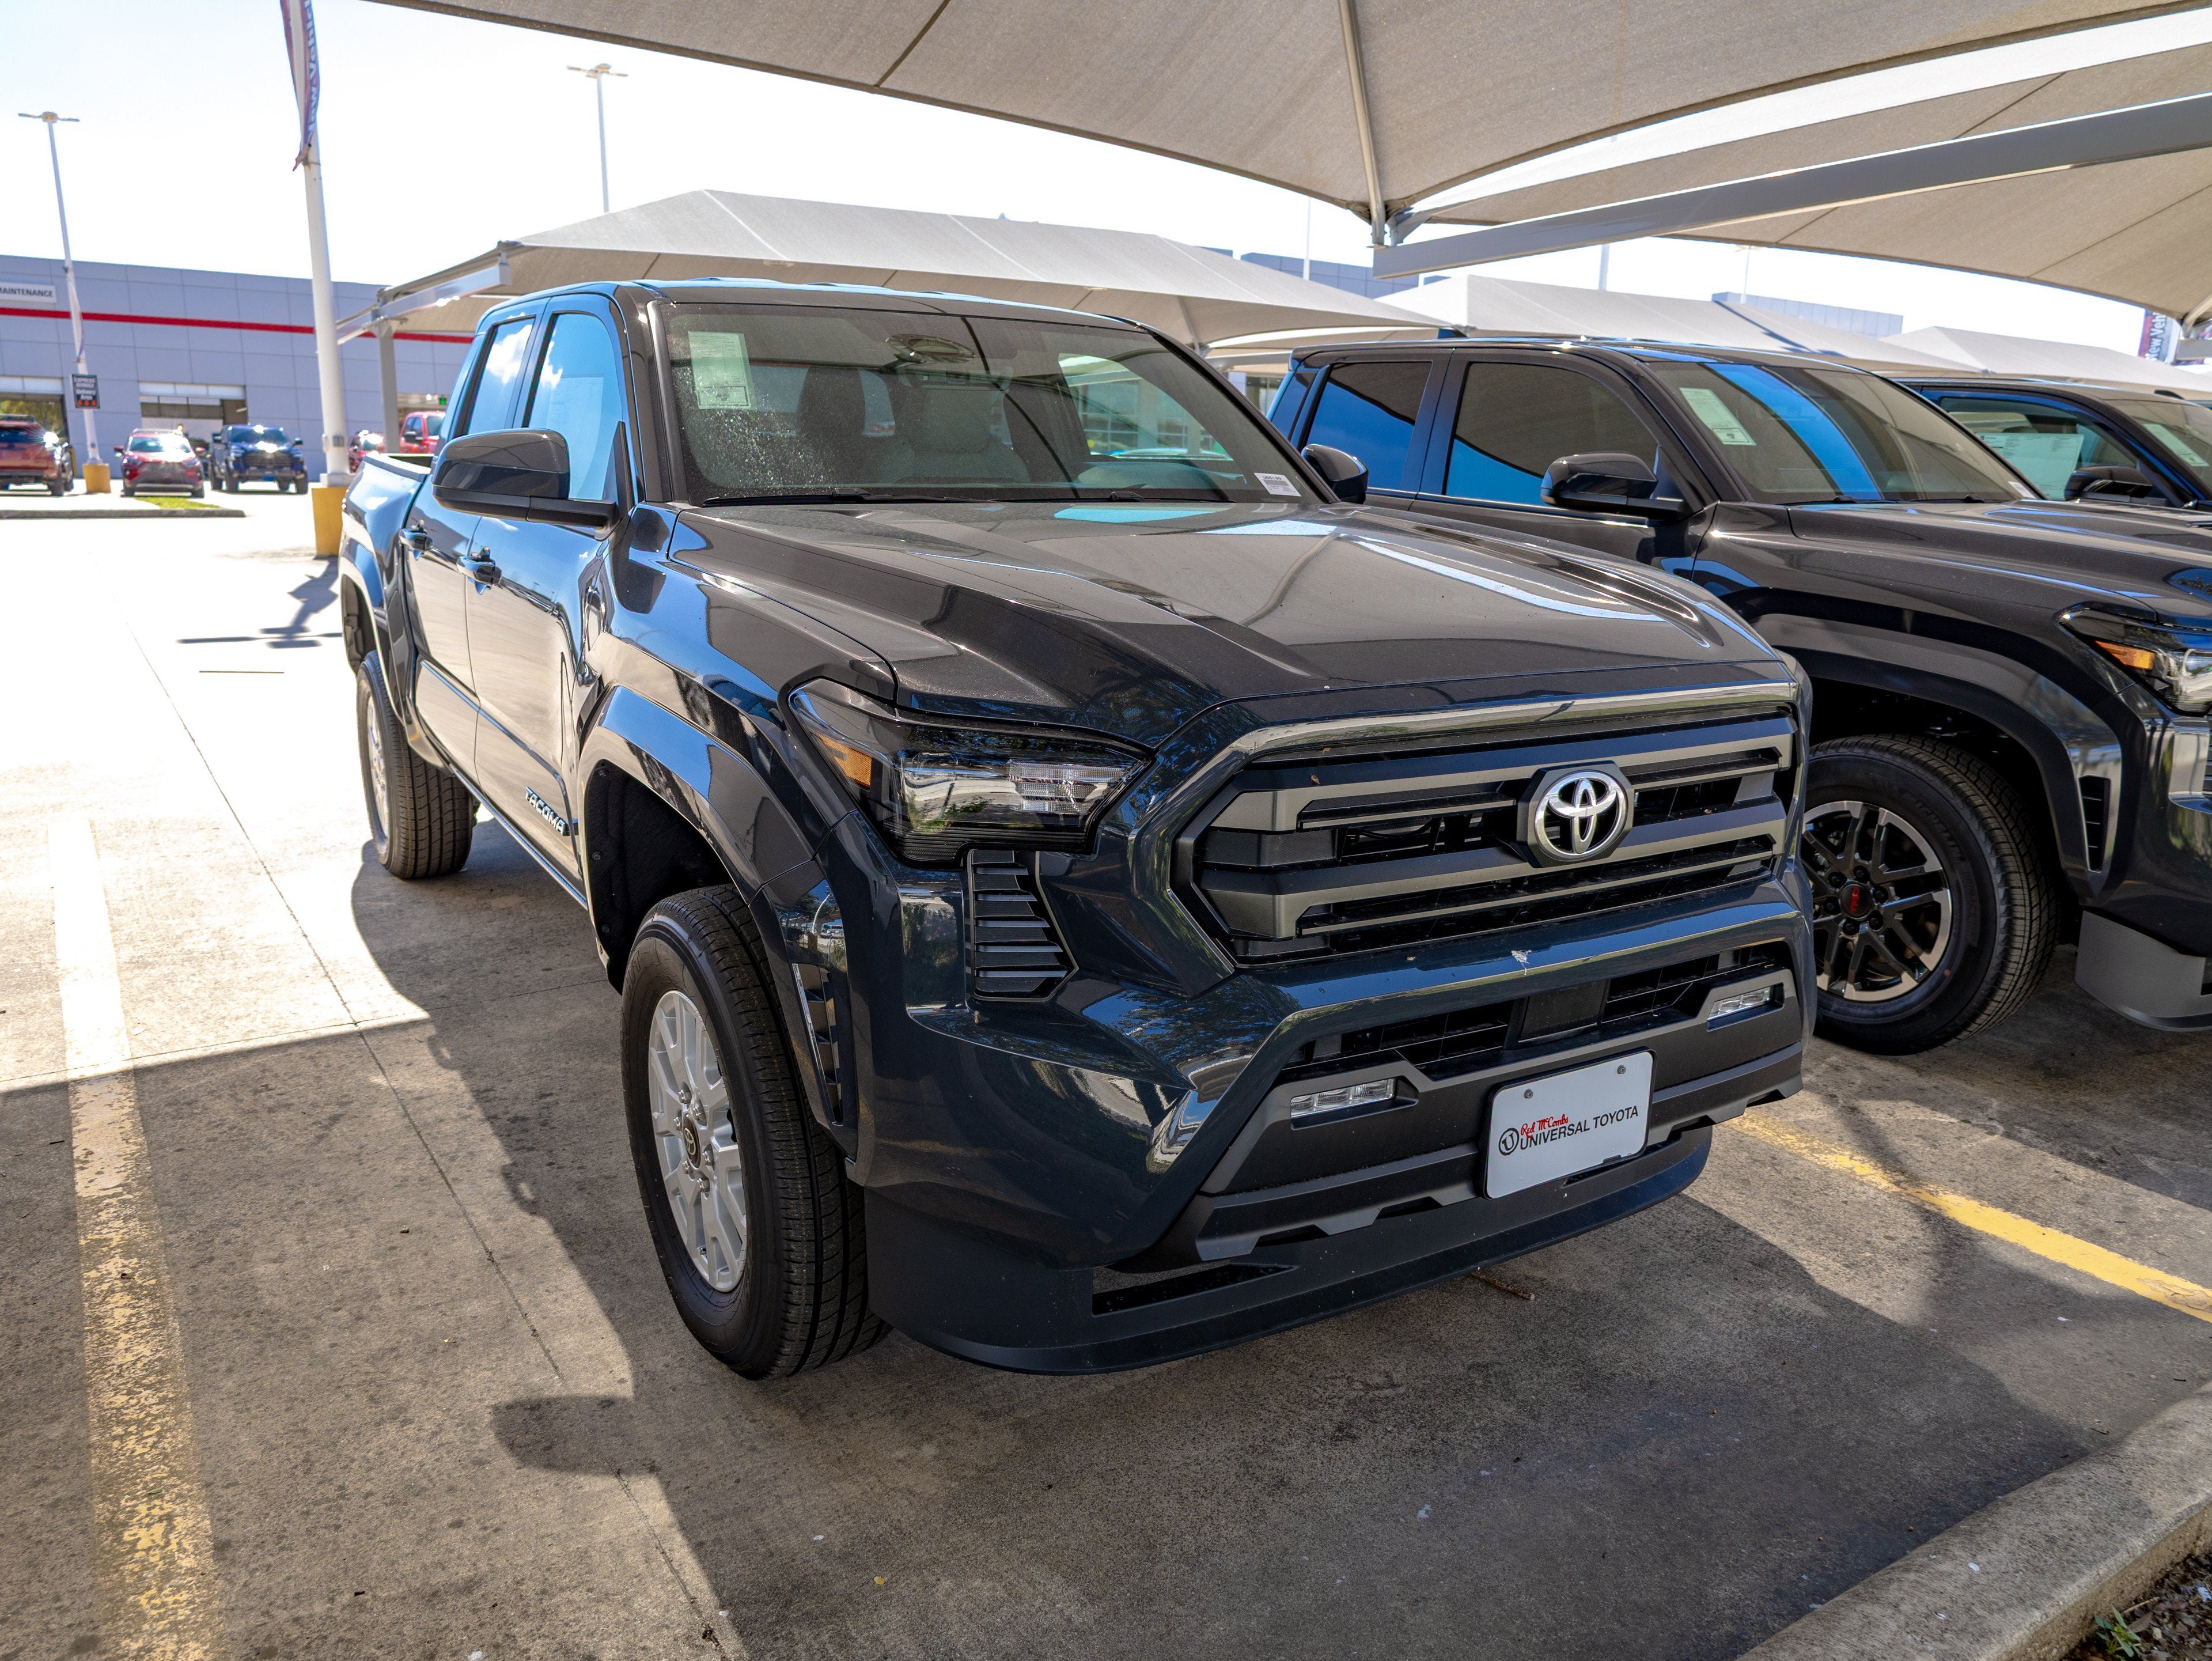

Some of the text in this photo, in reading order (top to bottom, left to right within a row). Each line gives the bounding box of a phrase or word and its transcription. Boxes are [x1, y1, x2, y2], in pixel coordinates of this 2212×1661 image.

[0, 287, 54, 297] AINTENANCE
[2145, 338, 2162, 361] New
[525, 786, 568, 836] TACOMA
[1850, 887, 1860, 913] TRD
[1520, 1119, 1590, 1150] UNIVERSAL
[1593, 1105, 1638, 1129] TOYOTA
[1520, 1123, 1535, 1138] Red
